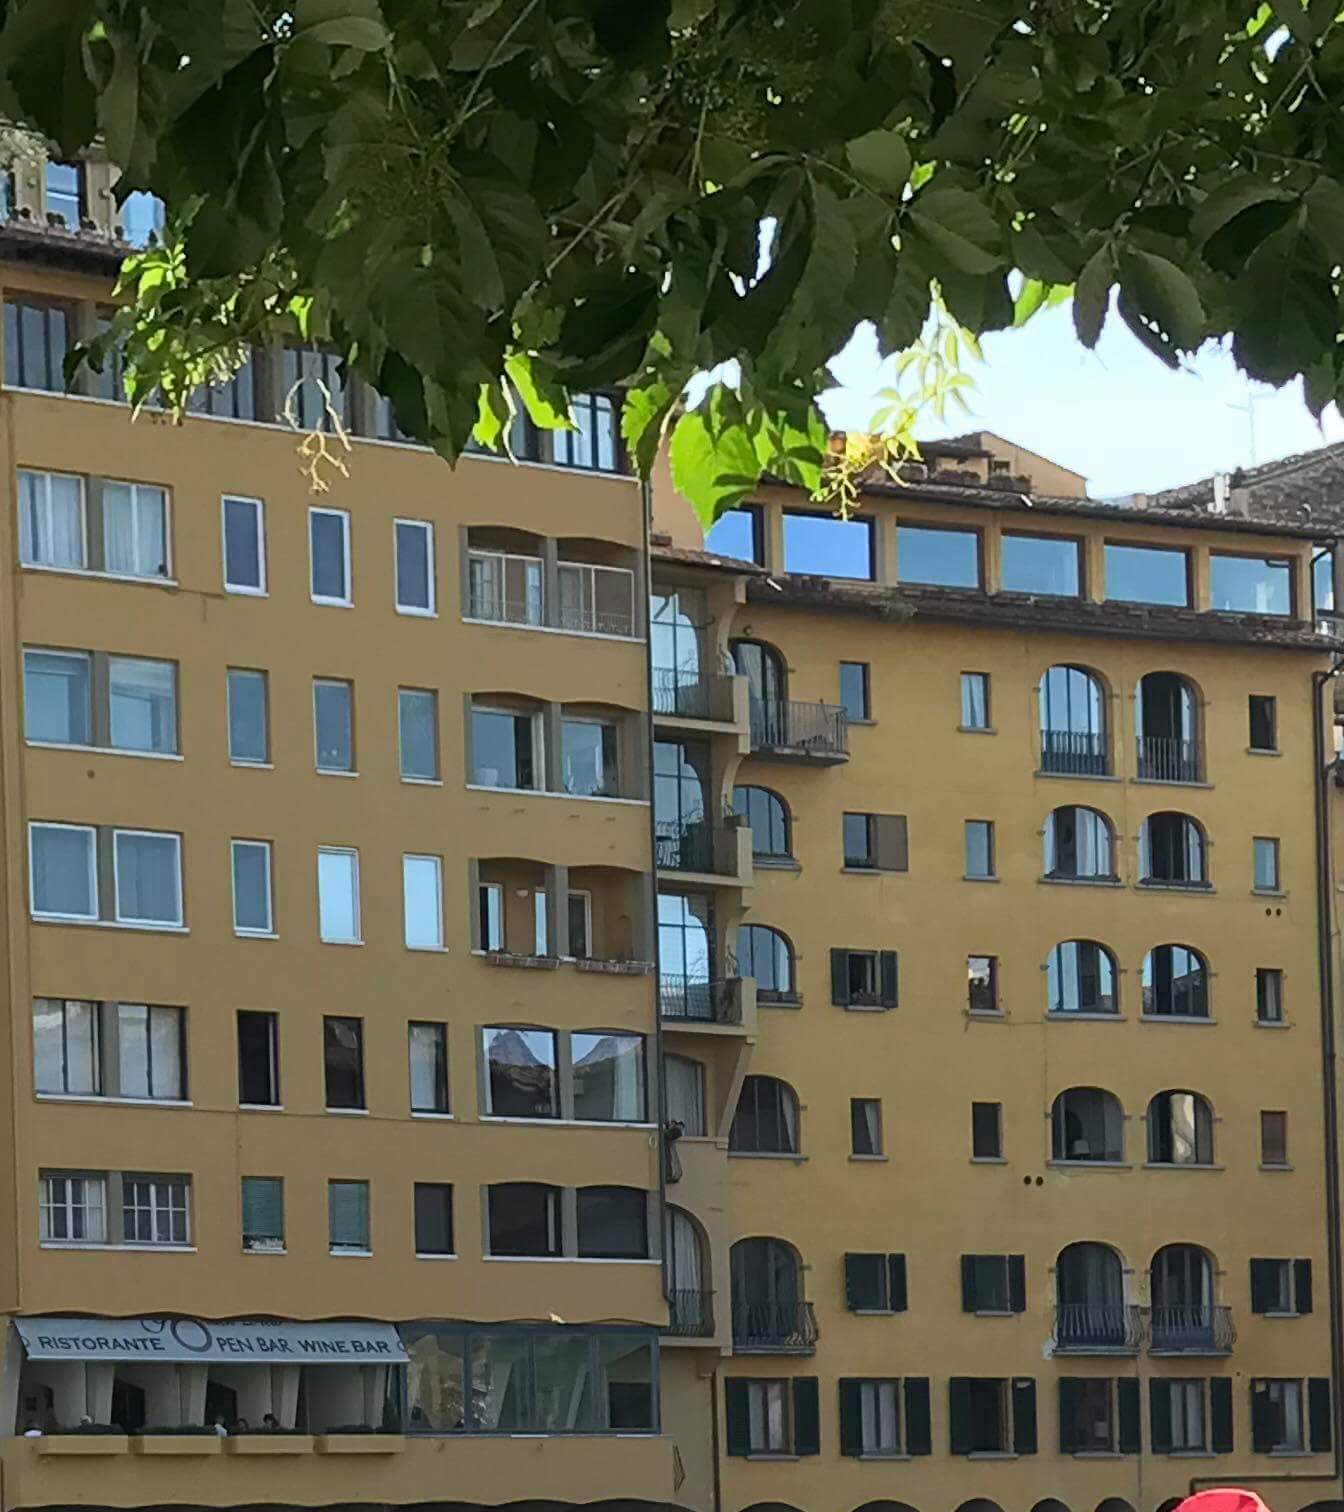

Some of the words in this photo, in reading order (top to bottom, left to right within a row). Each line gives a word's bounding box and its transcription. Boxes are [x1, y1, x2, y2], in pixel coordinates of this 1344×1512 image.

[38, 1335, 166, 1351] RISTORANTE
[256, 1336, 294, 1353] BAR
[297, 1339, 351, 1353] WINE
[351, 1339, 392, 1353] BAR
